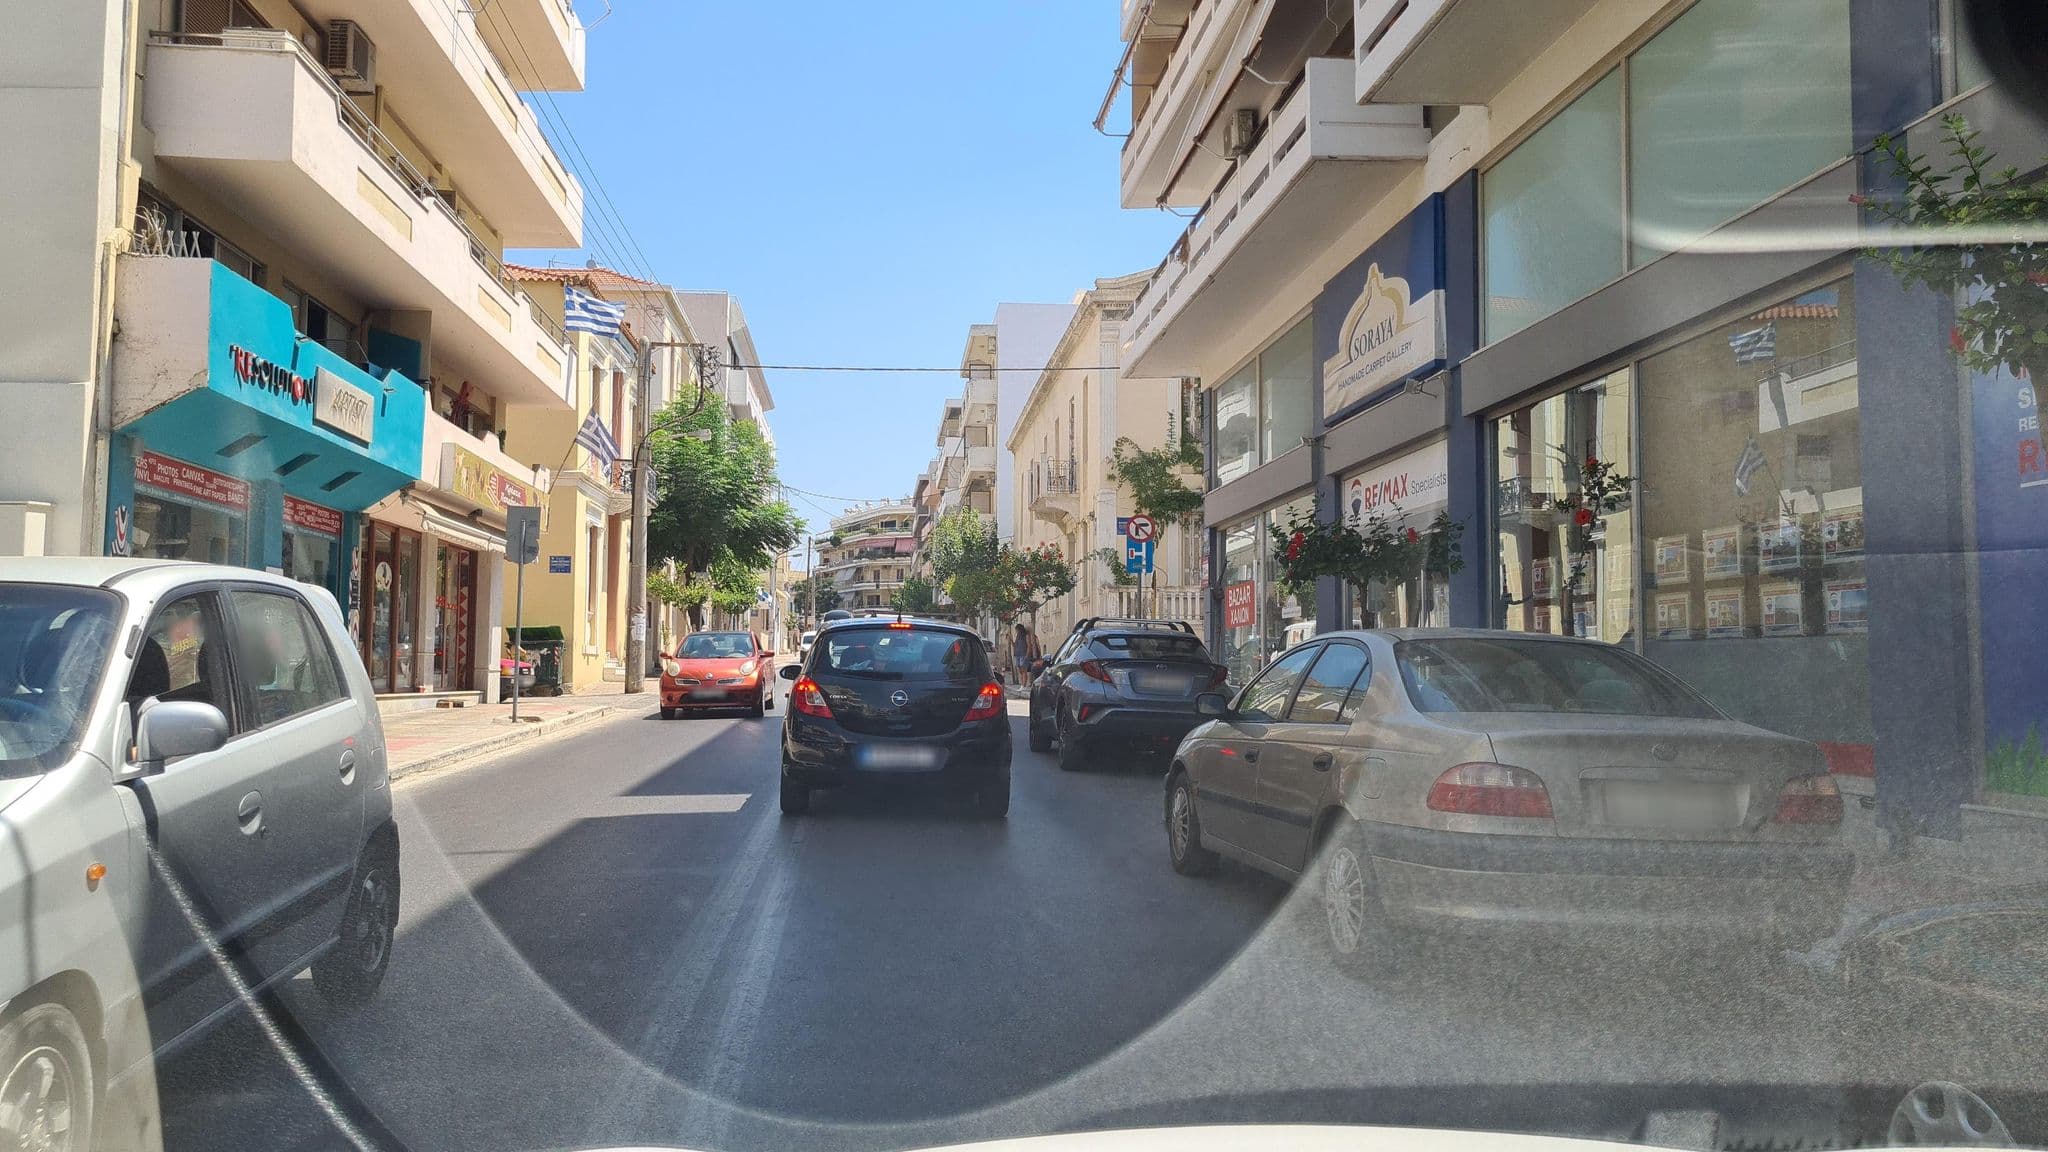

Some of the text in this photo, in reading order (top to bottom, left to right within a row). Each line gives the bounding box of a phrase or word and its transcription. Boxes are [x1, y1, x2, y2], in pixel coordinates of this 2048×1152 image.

[1353, 317, 1394, 360] SORAYA
[230, 344, 313, 404] RESOLUTION
[1337, 340, 1413, 391] HANDMADE CARPET GALLERY
[157, 463, 179, 478] PHOTOS
[182, 467, 205, 483] CANVAS
[1364, 473, 1408, 510] RE/MAX
[1411, 472, 1447, 497] Specialists
[1228, 585, 1251, 607] BAZAAR
